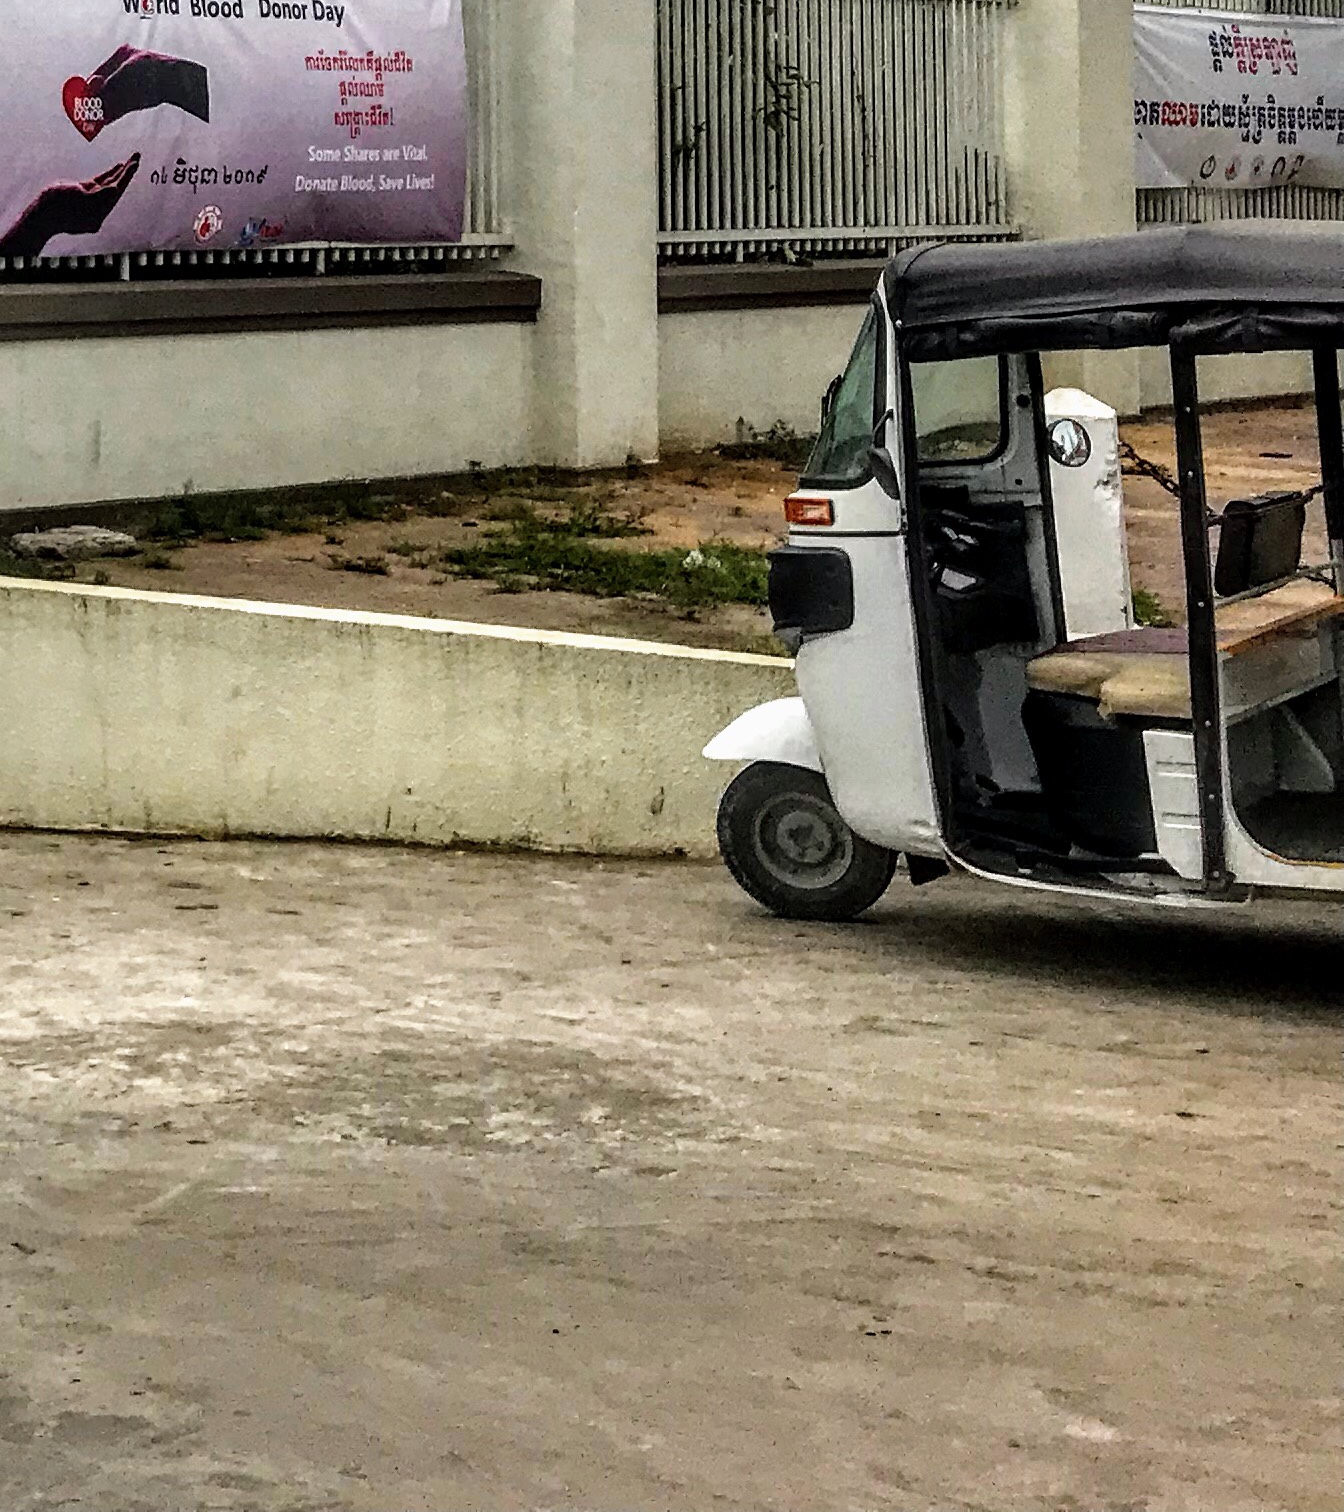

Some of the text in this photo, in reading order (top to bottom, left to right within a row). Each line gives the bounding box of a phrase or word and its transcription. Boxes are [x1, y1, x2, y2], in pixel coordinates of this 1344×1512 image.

[313, 0, 345, 27] Day
[74, 97, 103, 109] BLOOD
[74, 108, 104, 121] DONOR
[308, 145, 341, 161] Some
[344, 145, 379, 161] Shares
[383, 149, 400, 161] are
[173, 157, 218, 194] មិថុនា
[223, 165, 268, 185] ២០១៩
[295, 175, 337, 192] Donate
[379, 175, 403, 190] Save
